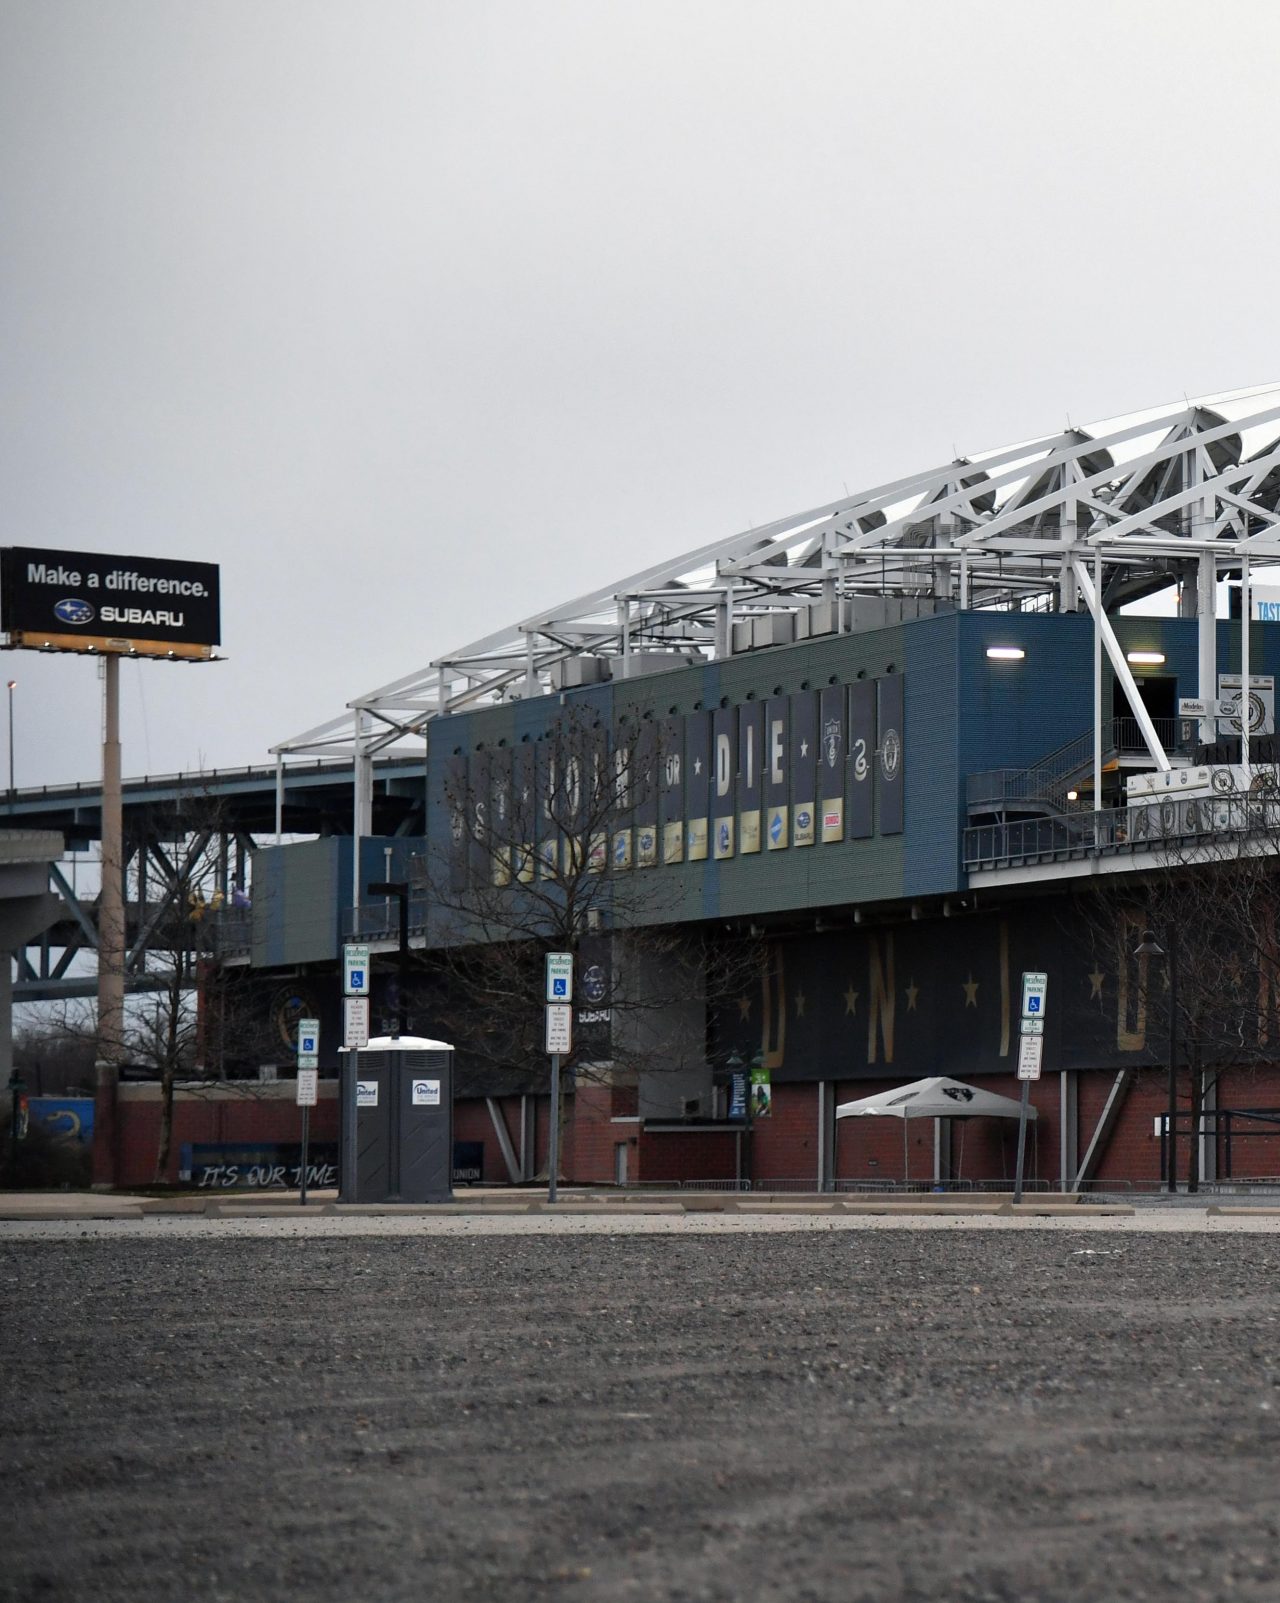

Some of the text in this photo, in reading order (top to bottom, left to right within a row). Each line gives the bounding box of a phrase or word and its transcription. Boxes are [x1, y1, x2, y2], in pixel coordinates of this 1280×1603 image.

[27, 563, 209, 597] Make a difference.
[100, 606, 184, 627] SUBARU
[717, 720, 784, 797] DIE
[248, 1166, 286, 1187] OUR
